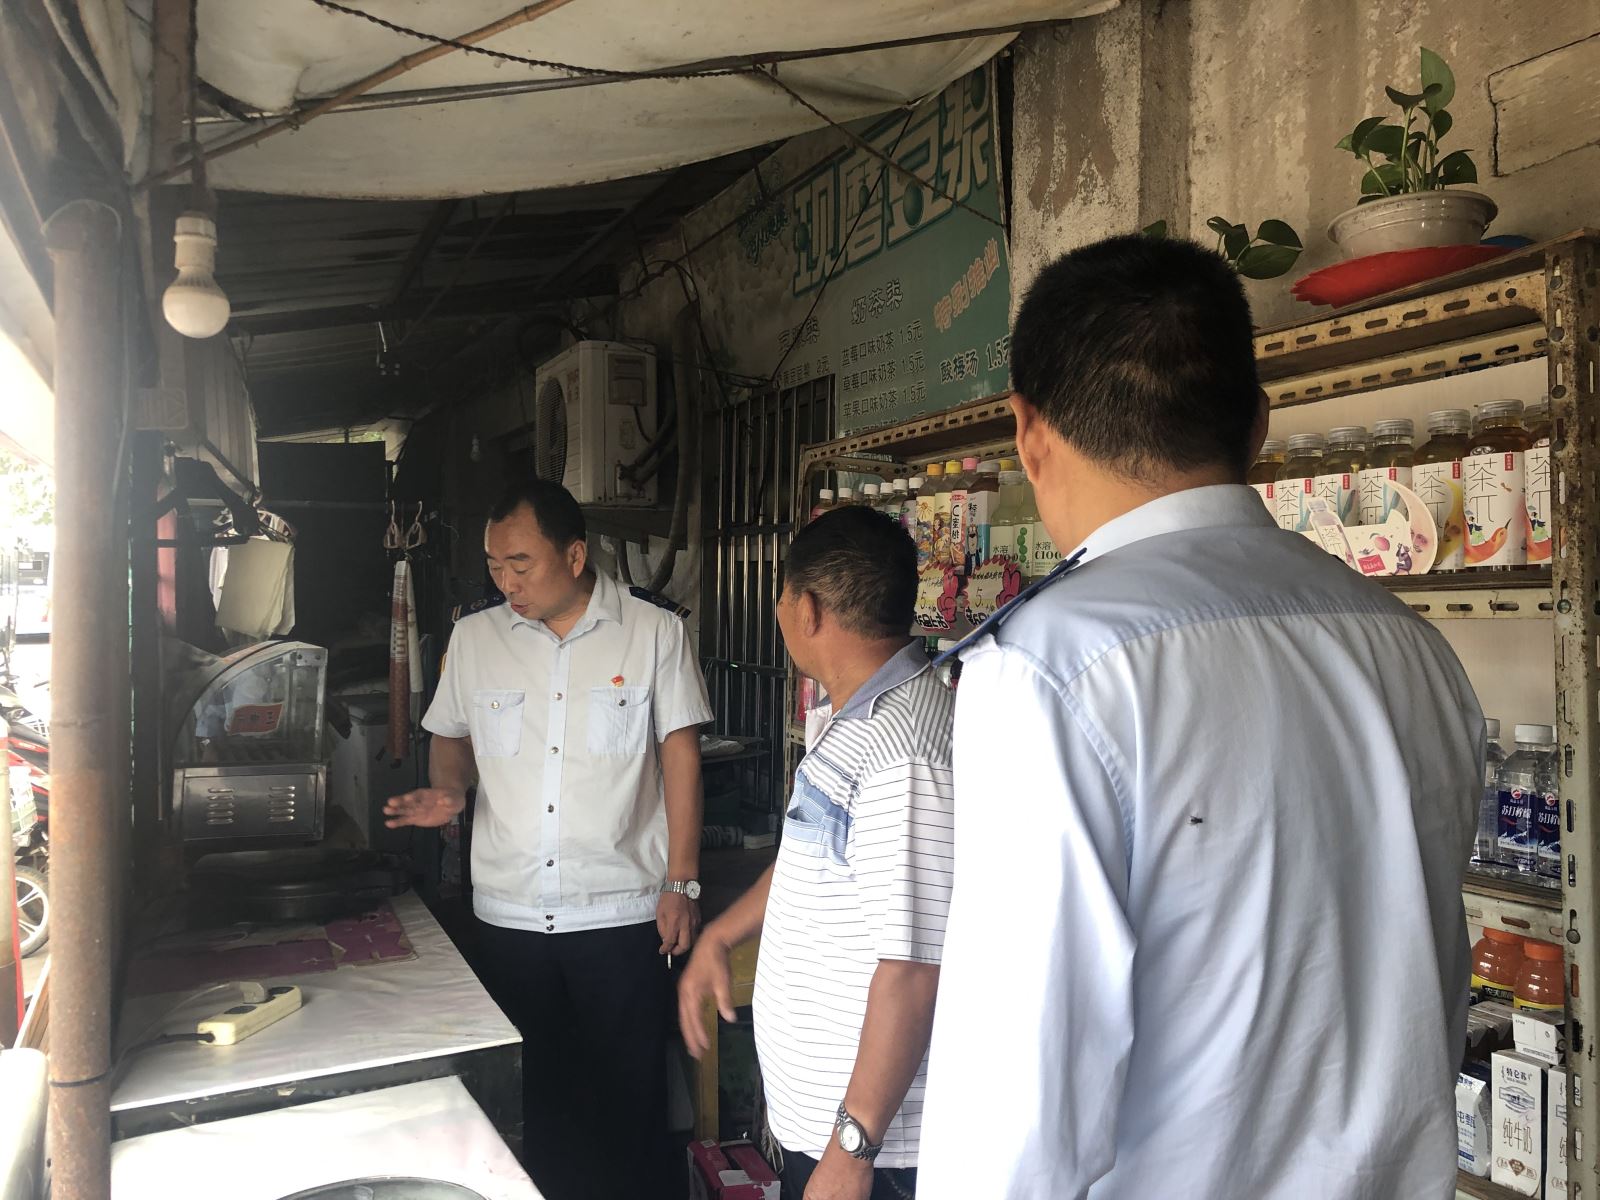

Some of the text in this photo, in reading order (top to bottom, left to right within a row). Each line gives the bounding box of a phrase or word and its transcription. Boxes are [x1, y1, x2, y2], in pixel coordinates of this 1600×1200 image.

[851, 278, 904, 325] 奶茶类
[843, 360, 896, 390] 草莓口味奶茶
[940, 350, 978, 383] 酸梅汤
[843, 390, 897, 416] 苹果口味奶茶
[1035, 541, 1051, 551] 水溶
[1503, 1117, 1532, 1154] 纯牛奶
